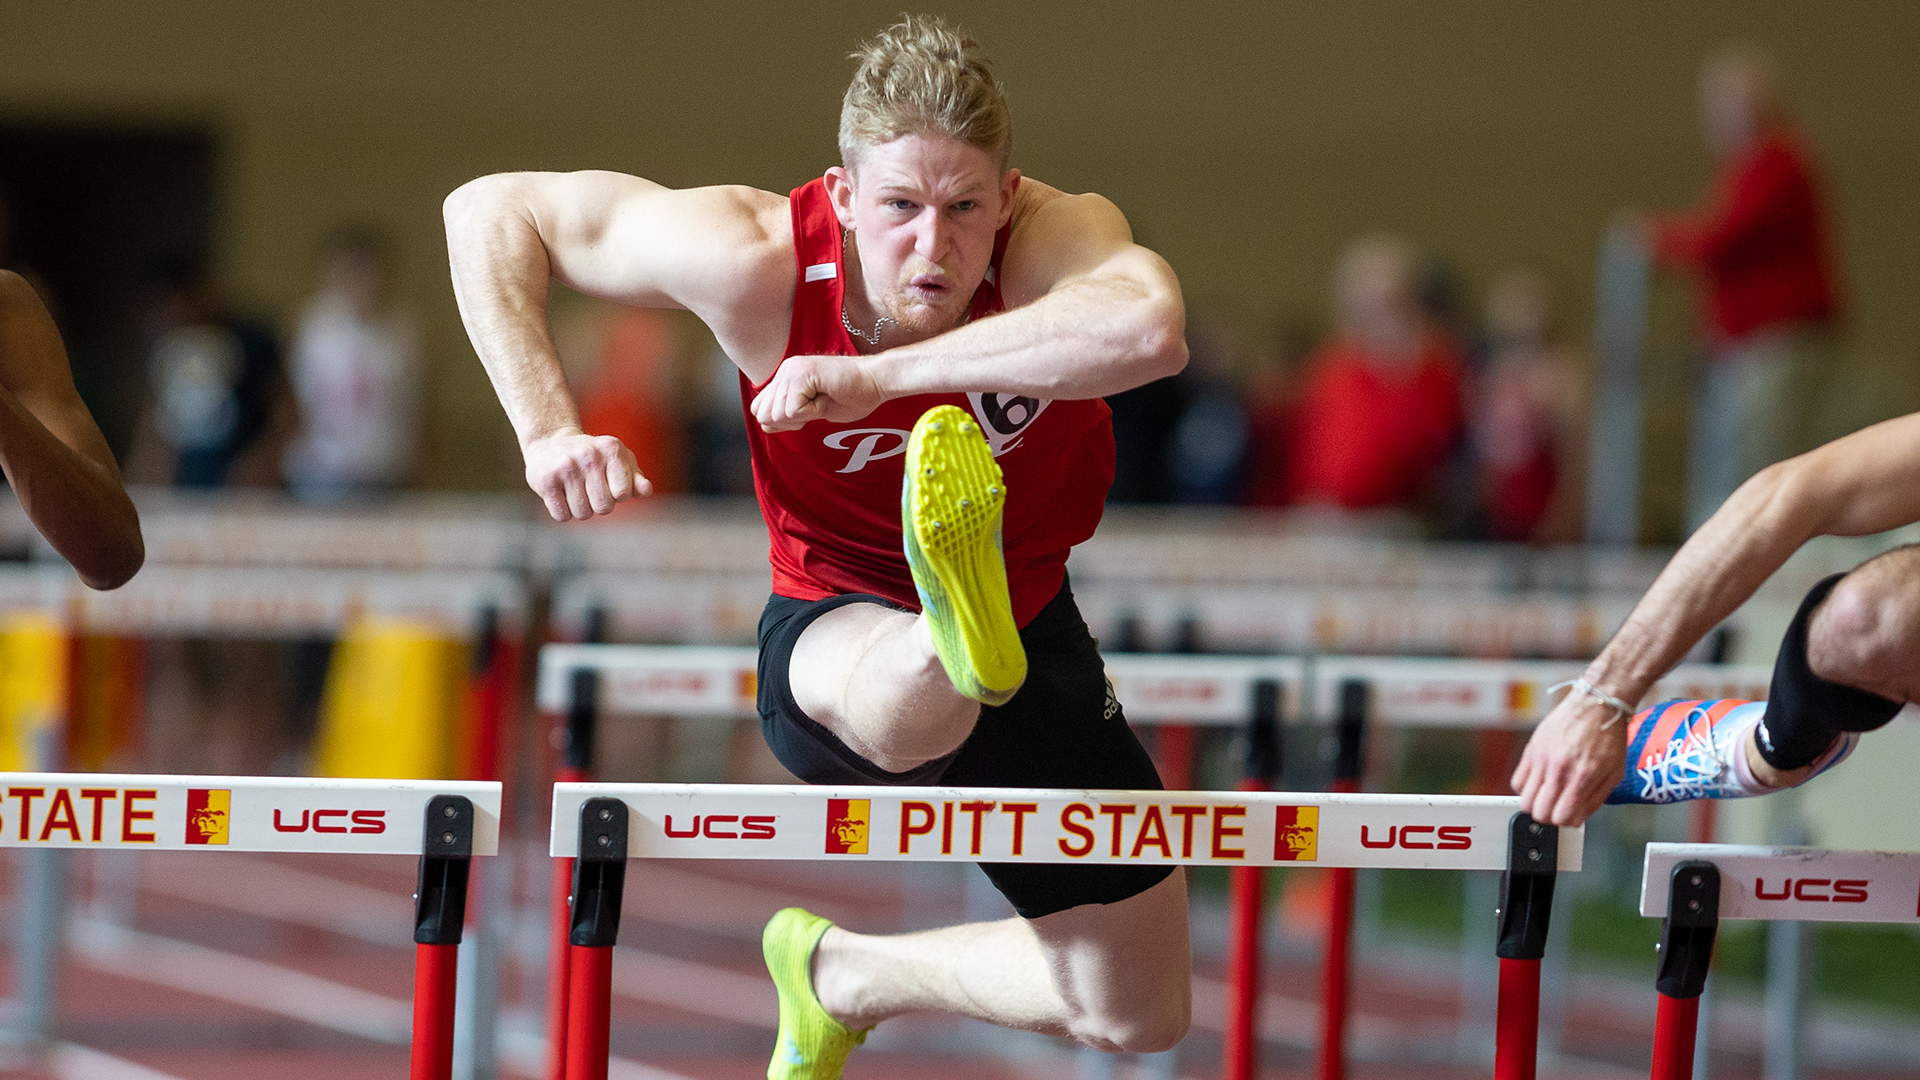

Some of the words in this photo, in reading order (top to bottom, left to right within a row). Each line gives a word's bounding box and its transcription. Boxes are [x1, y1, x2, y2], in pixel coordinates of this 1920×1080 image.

[981, 392, 1040, 435] 6
[0, 786, 158, 843] TATE
[273, 808, 386, 834] UCS
[664, 814, 776, 840] UCS
[899, 800, 1038, 856] PITT
[1057, 802, 1247, 860] STATE
[1360, 824, 1472, 850] UCS
[1755, 877, 1868, 903] UCS
